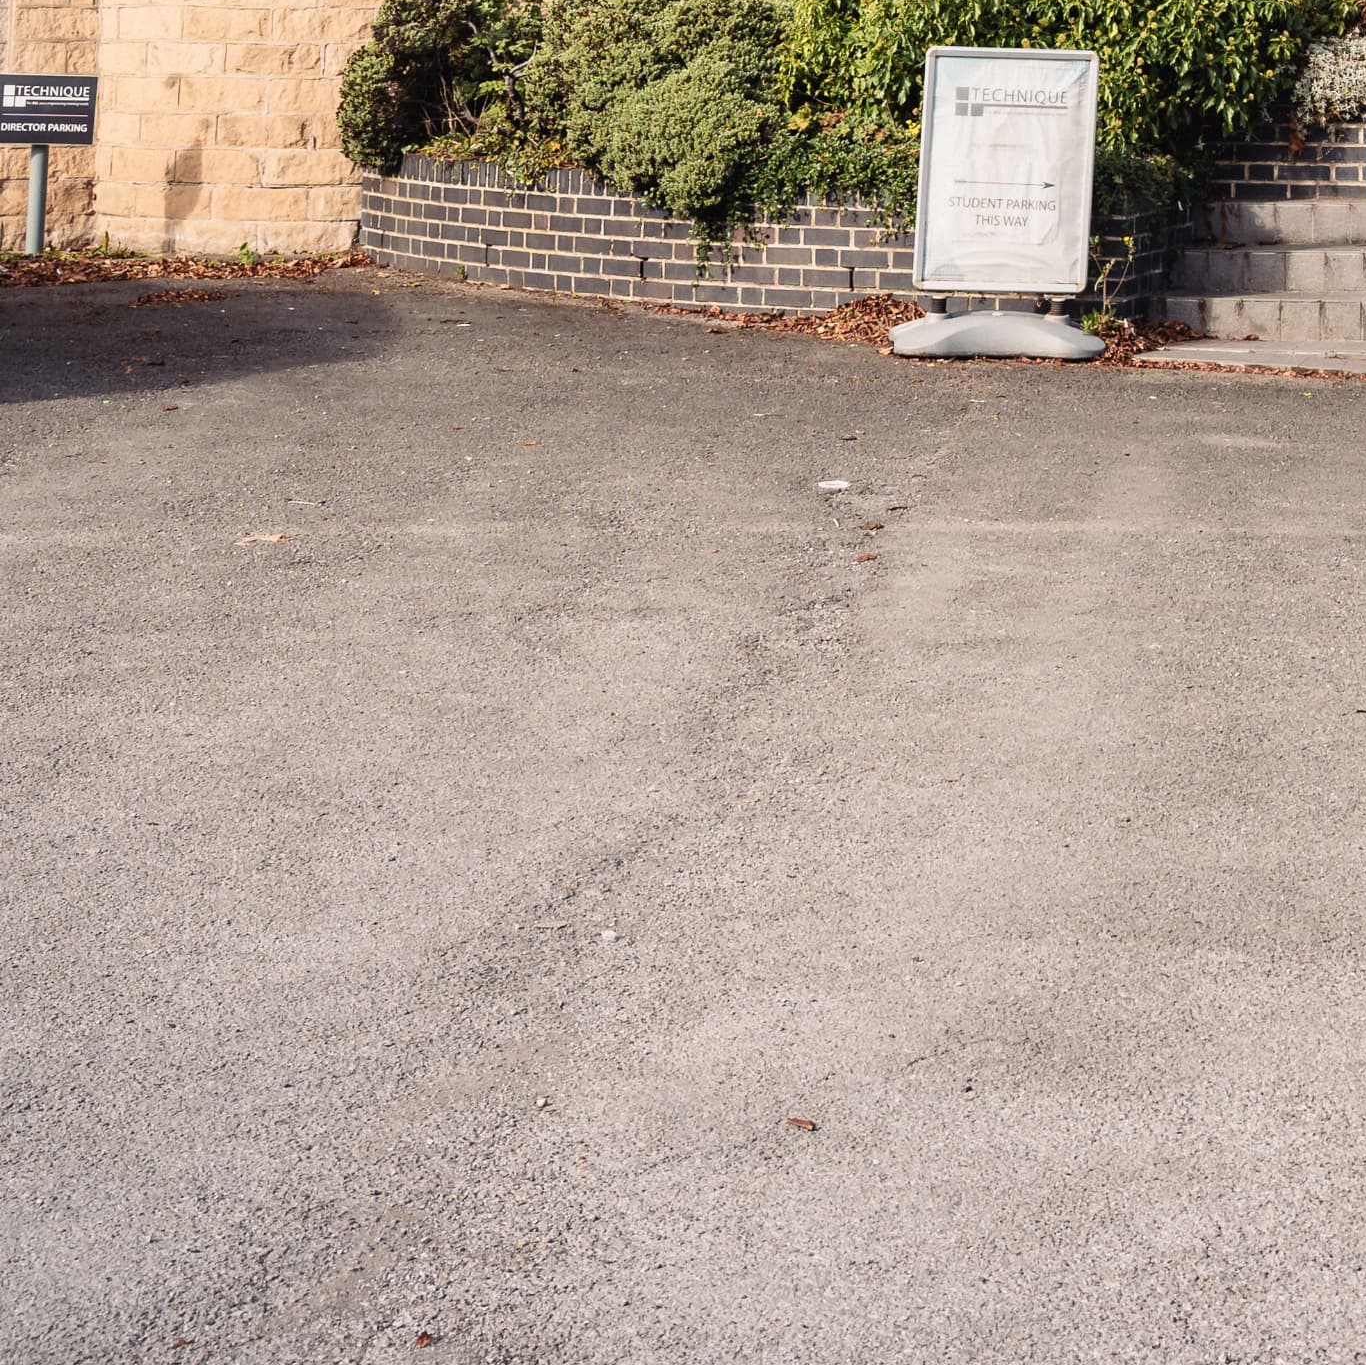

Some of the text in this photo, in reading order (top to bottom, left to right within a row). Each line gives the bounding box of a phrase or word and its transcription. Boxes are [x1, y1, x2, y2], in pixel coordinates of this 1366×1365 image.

[15, 85, 91, 98] TECHNIQUE
[971, 87, 1068, 105] TECHNIQUE
[0, 122, 88, 133] DIRECTOR PARKING
[948, 196, 1056, 212] STUDENT PARKING
[975, 214, 1029, 227] THIS WAY
